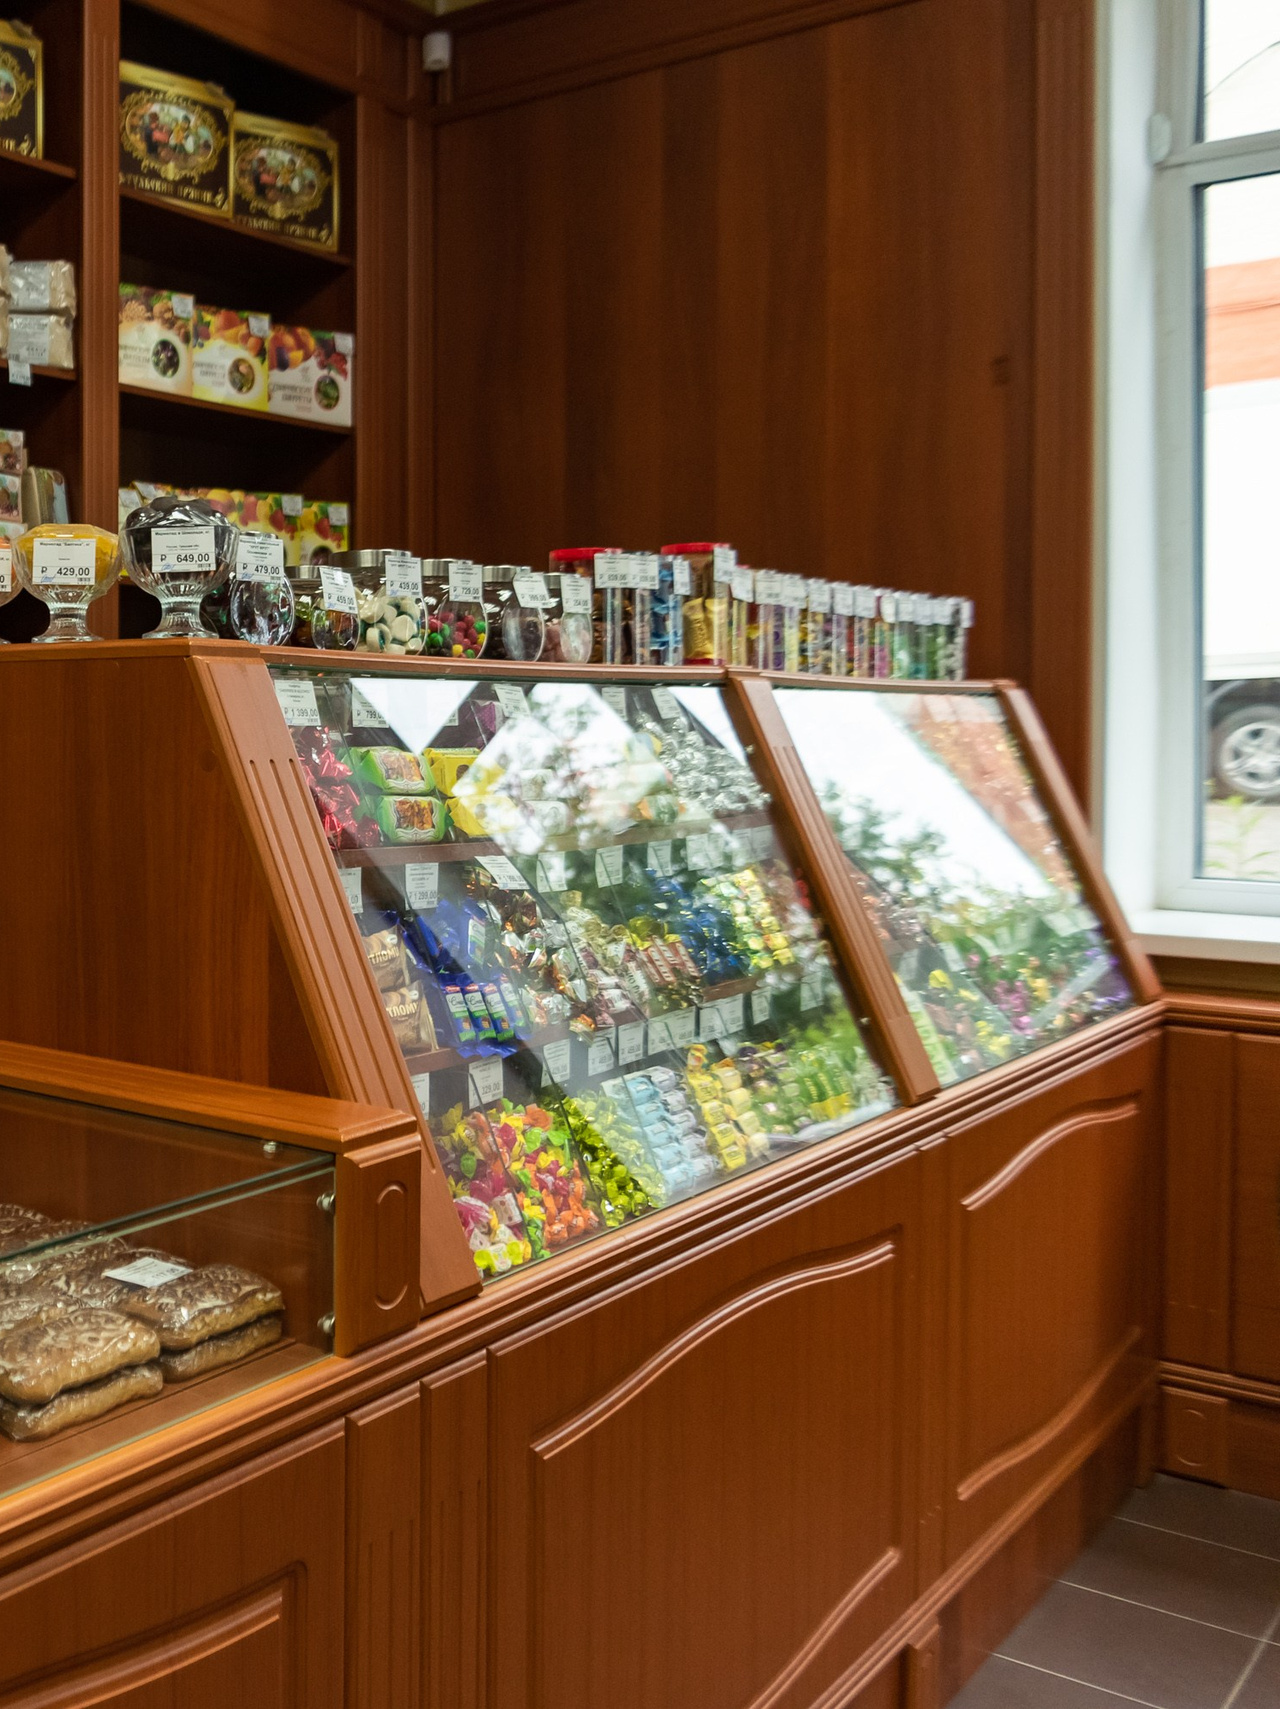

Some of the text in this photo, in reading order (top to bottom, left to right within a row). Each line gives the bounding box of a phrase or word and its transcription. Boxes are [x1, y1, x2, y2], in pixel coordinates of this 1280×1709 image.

[176, 553, 210, 563] 649,00
[56, 567, 90, 577] 429,00
[254, 565, 280, 575] 479,00
[398, 582, 419, 591] 439,00
[296, 708, 319, 717] 399,00
